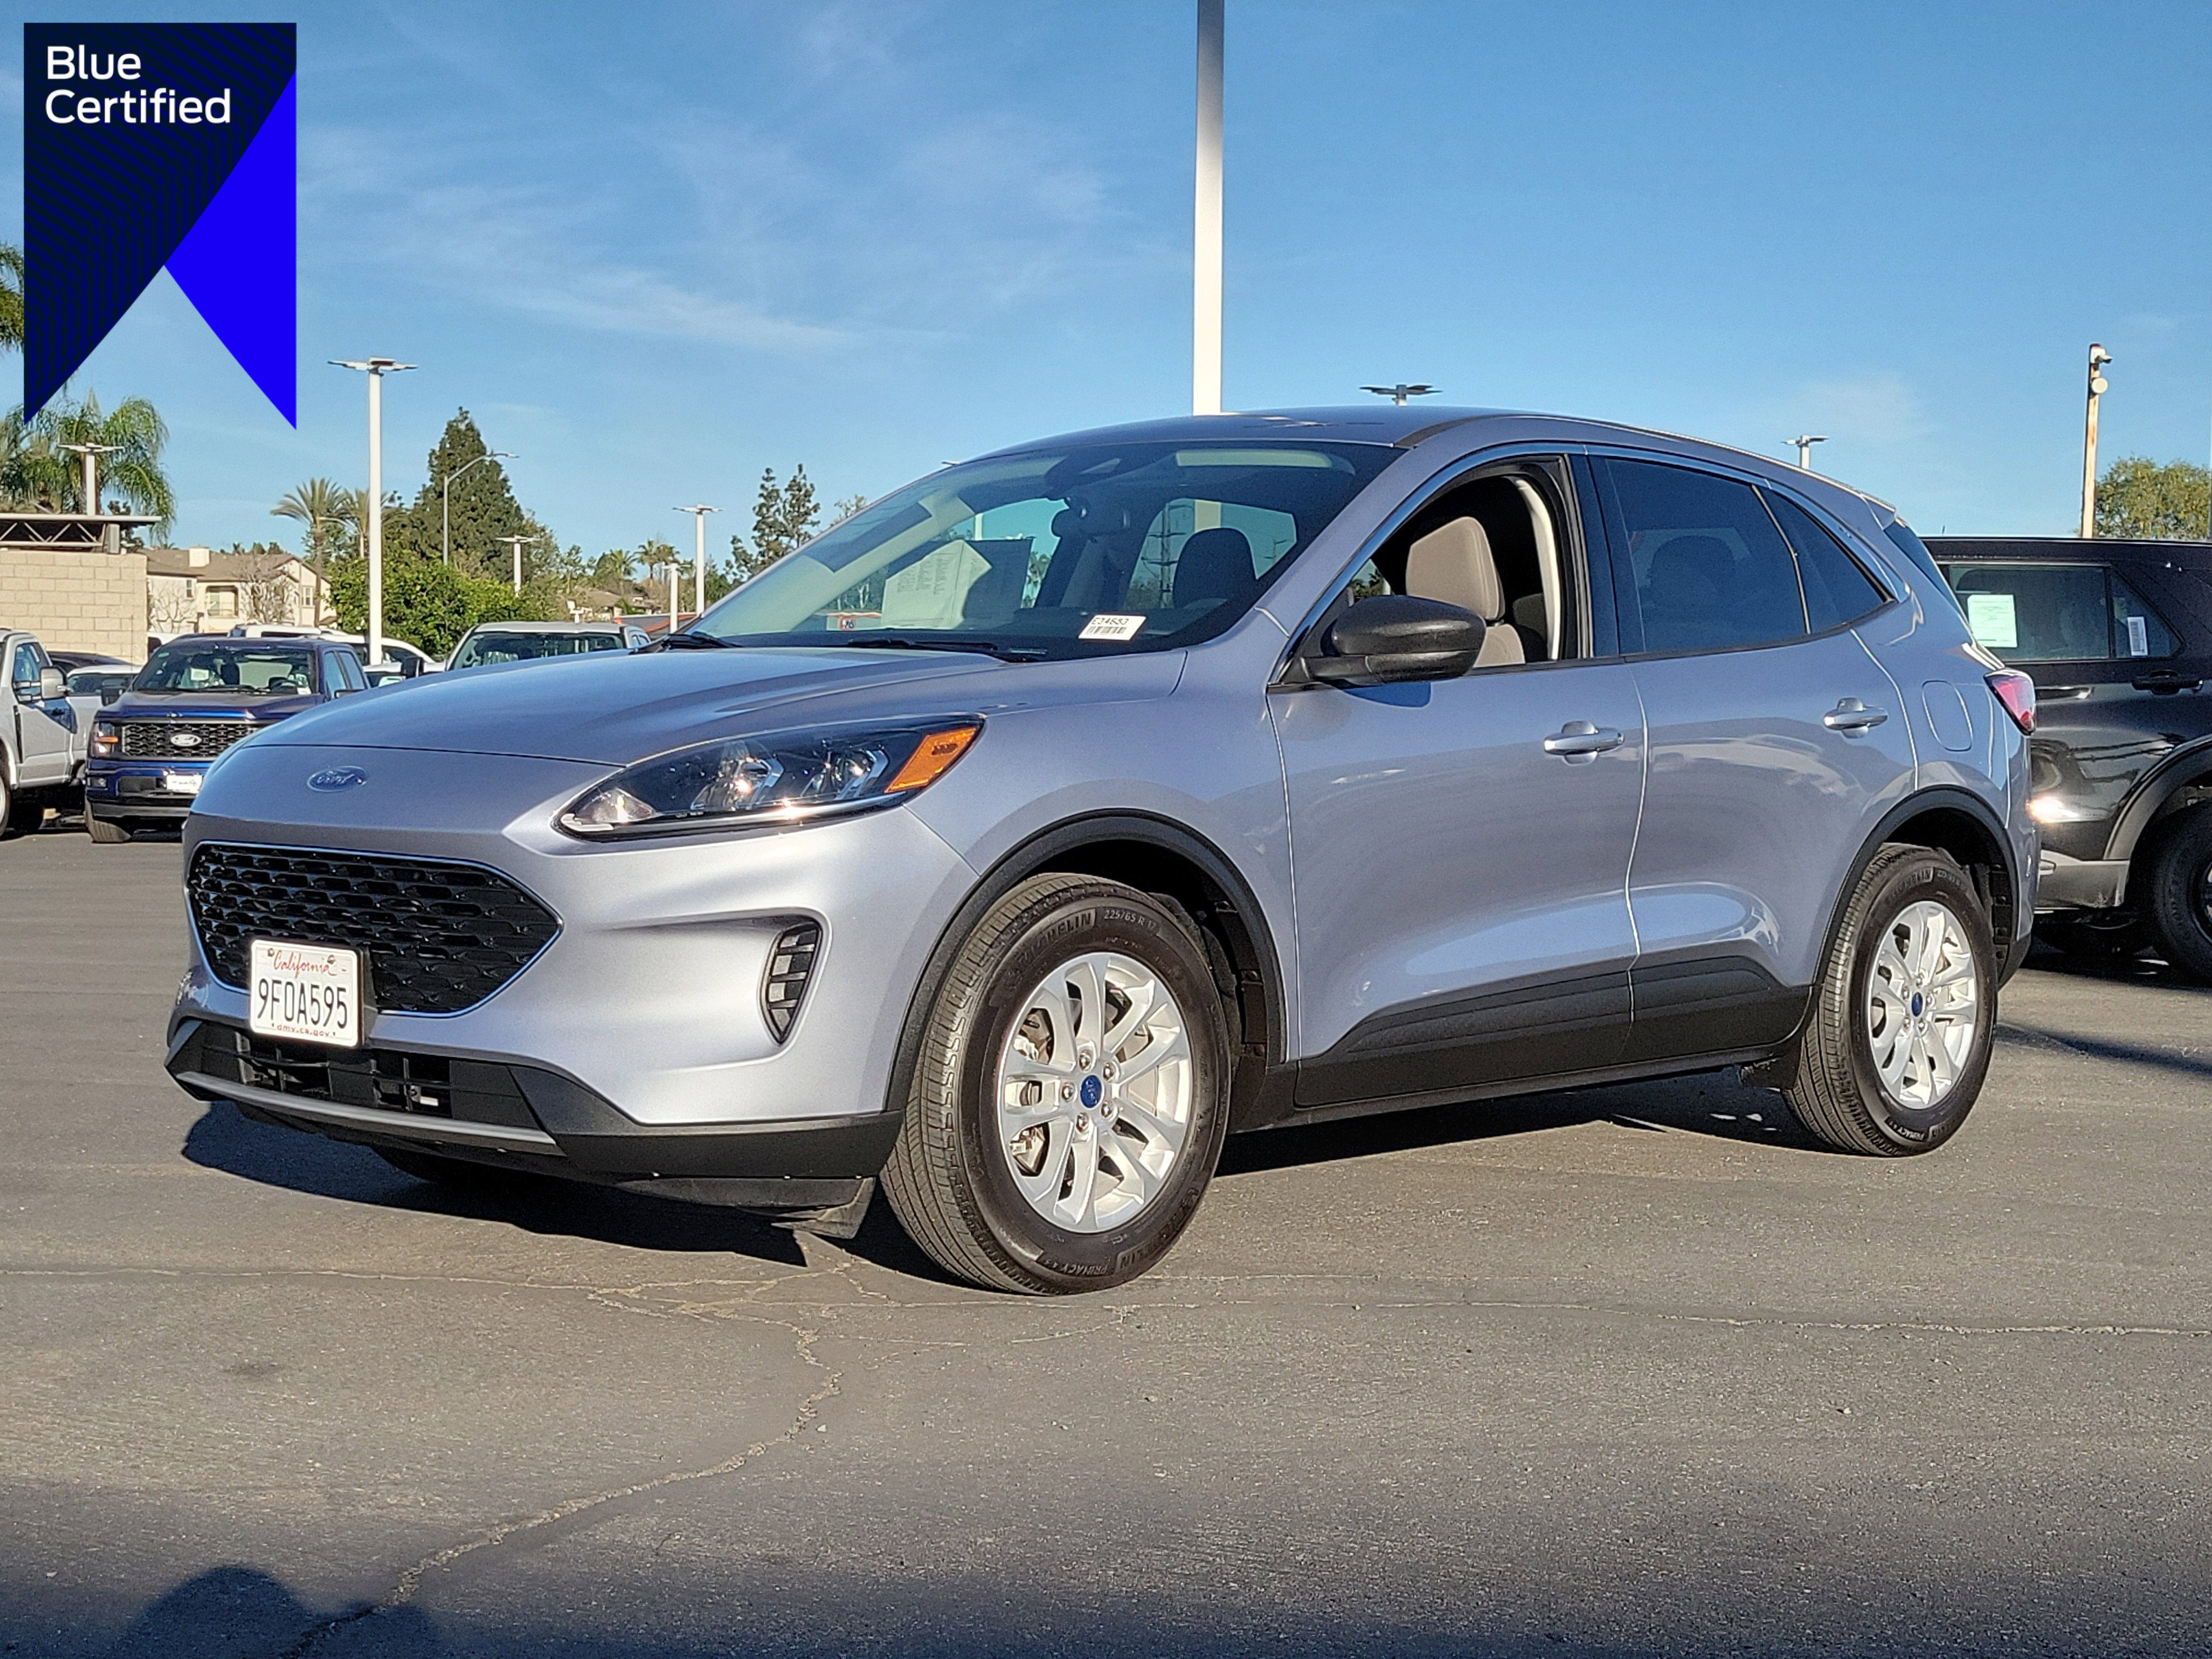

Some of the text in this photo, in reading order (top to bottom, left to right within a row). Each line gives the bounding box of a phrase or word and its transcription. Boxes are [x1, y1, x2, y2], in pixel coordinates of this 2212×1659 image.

[1104, 909, 1156, 931] 225/65 R 17
[274, 950, 337, 978] California
[1060, 1263, 1108, 1276] PRIMACY
